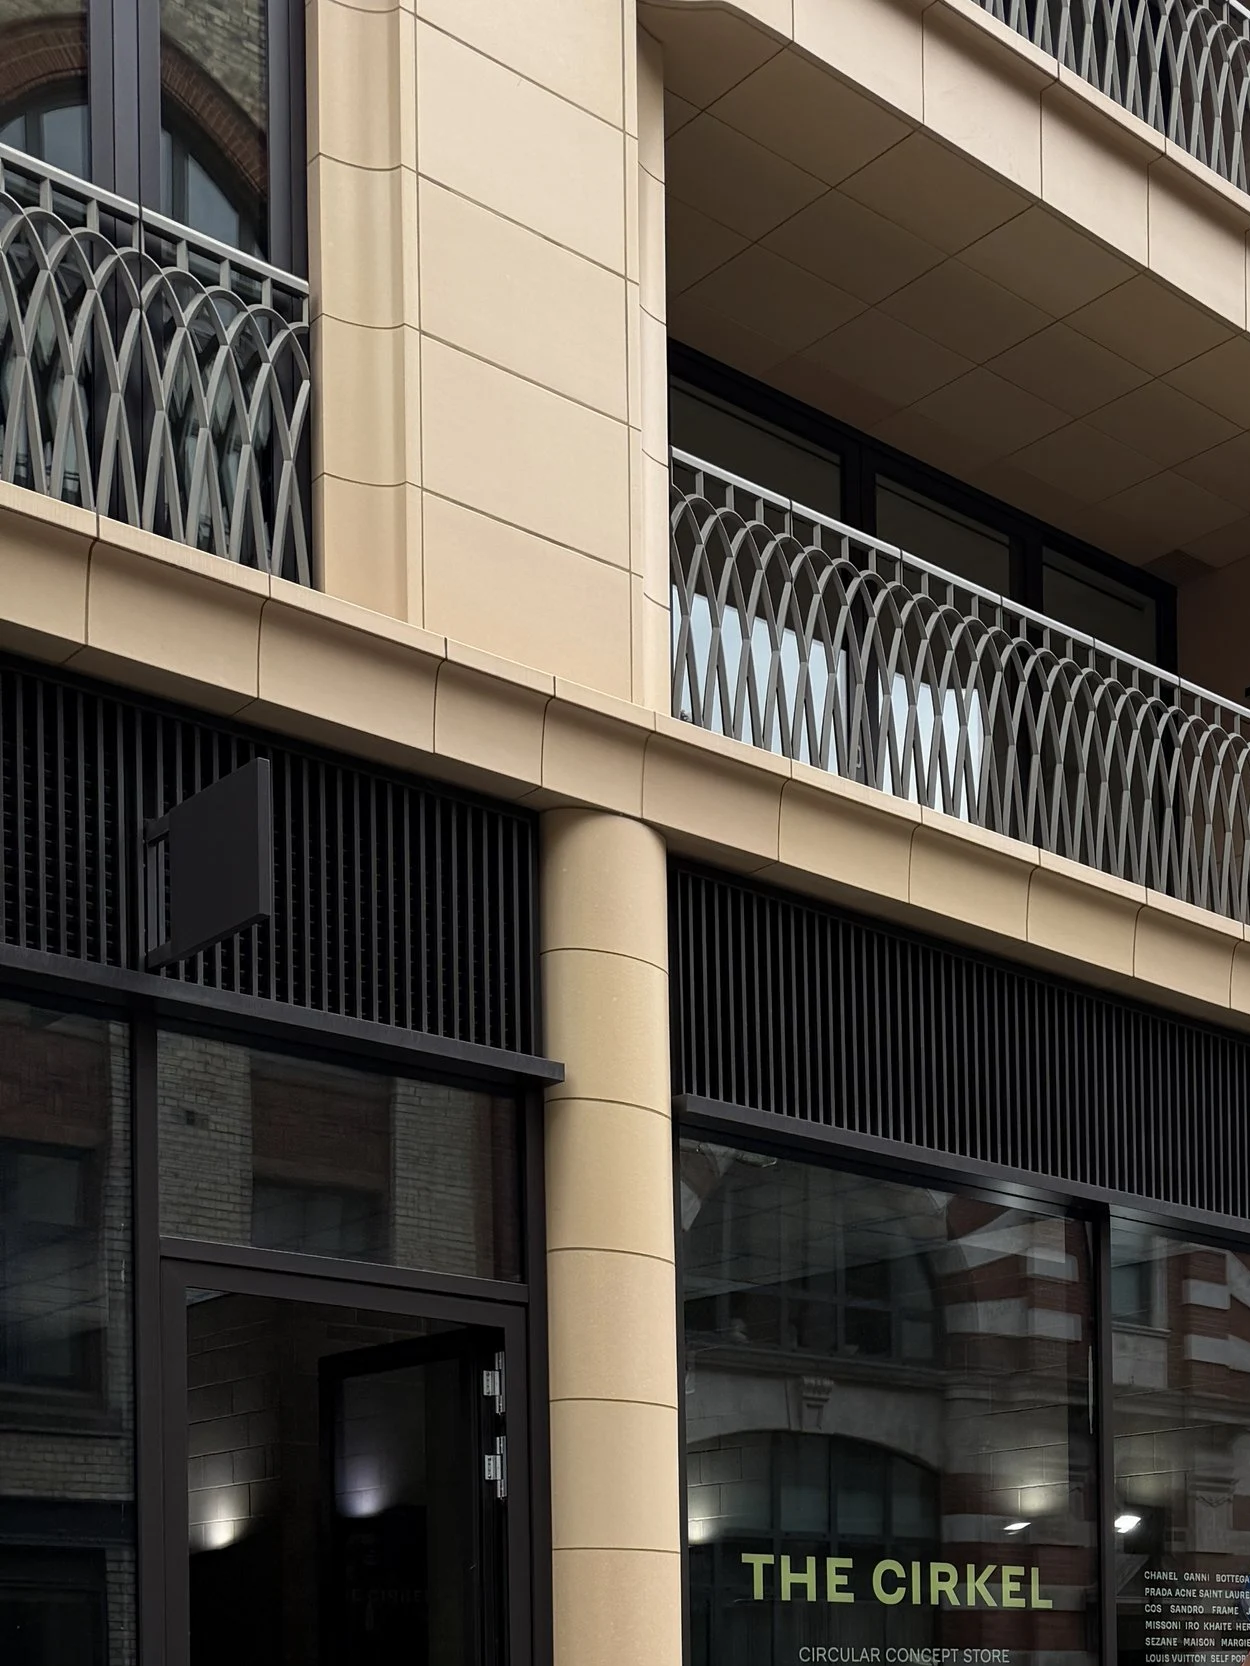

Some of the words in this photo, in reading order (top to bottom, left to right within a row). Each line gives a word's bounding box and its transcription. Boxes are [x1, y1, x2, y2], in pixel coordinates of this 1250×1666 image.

[741, 1552, 855, 1603] THE
[872, 1559, 1053, 1609] CIRKEL
[1144, 1571, 1178, 1581] CHANEL
[1184, 1573, 1210, 1582] GANNI
[1216, 1574, 1250, 1584] BOTTEGA
[1145, 1588, 1173, 1597] PRADA
[1175, 1588, 1197, 1598] ACNE
[1199, 1590, 1223, 1599] SAINT
[1145, 1604, 1162, 1613] COS
[1170, 1605, 1205, 1614] SANDRO
[1212, 1606, 1239, 1615] FRAME
[1145, 1621, 1181, 1631] MISSONI
[1185, 1621, 1200, 1630] IRO
[1203, 1622, 1232, 1631] KHAITE
[1145, 1637, 1178, 1647] SEZANE
[1183, 1638, 1215, 1648] MAISON
[799, 1646, 880, 1663] CIRCULAR
[886, 1647, 959, 1664] CONCEPT
[963, 1648, 1010, 1664] STORE
[1145, 1654, 1170, 1663] LOUIS
[1172, 1654, 1206, 1663] VUITTON
[1211, 1655, 1228, 1663] SELF
[1231, 1655, 1247, 1664] POR
